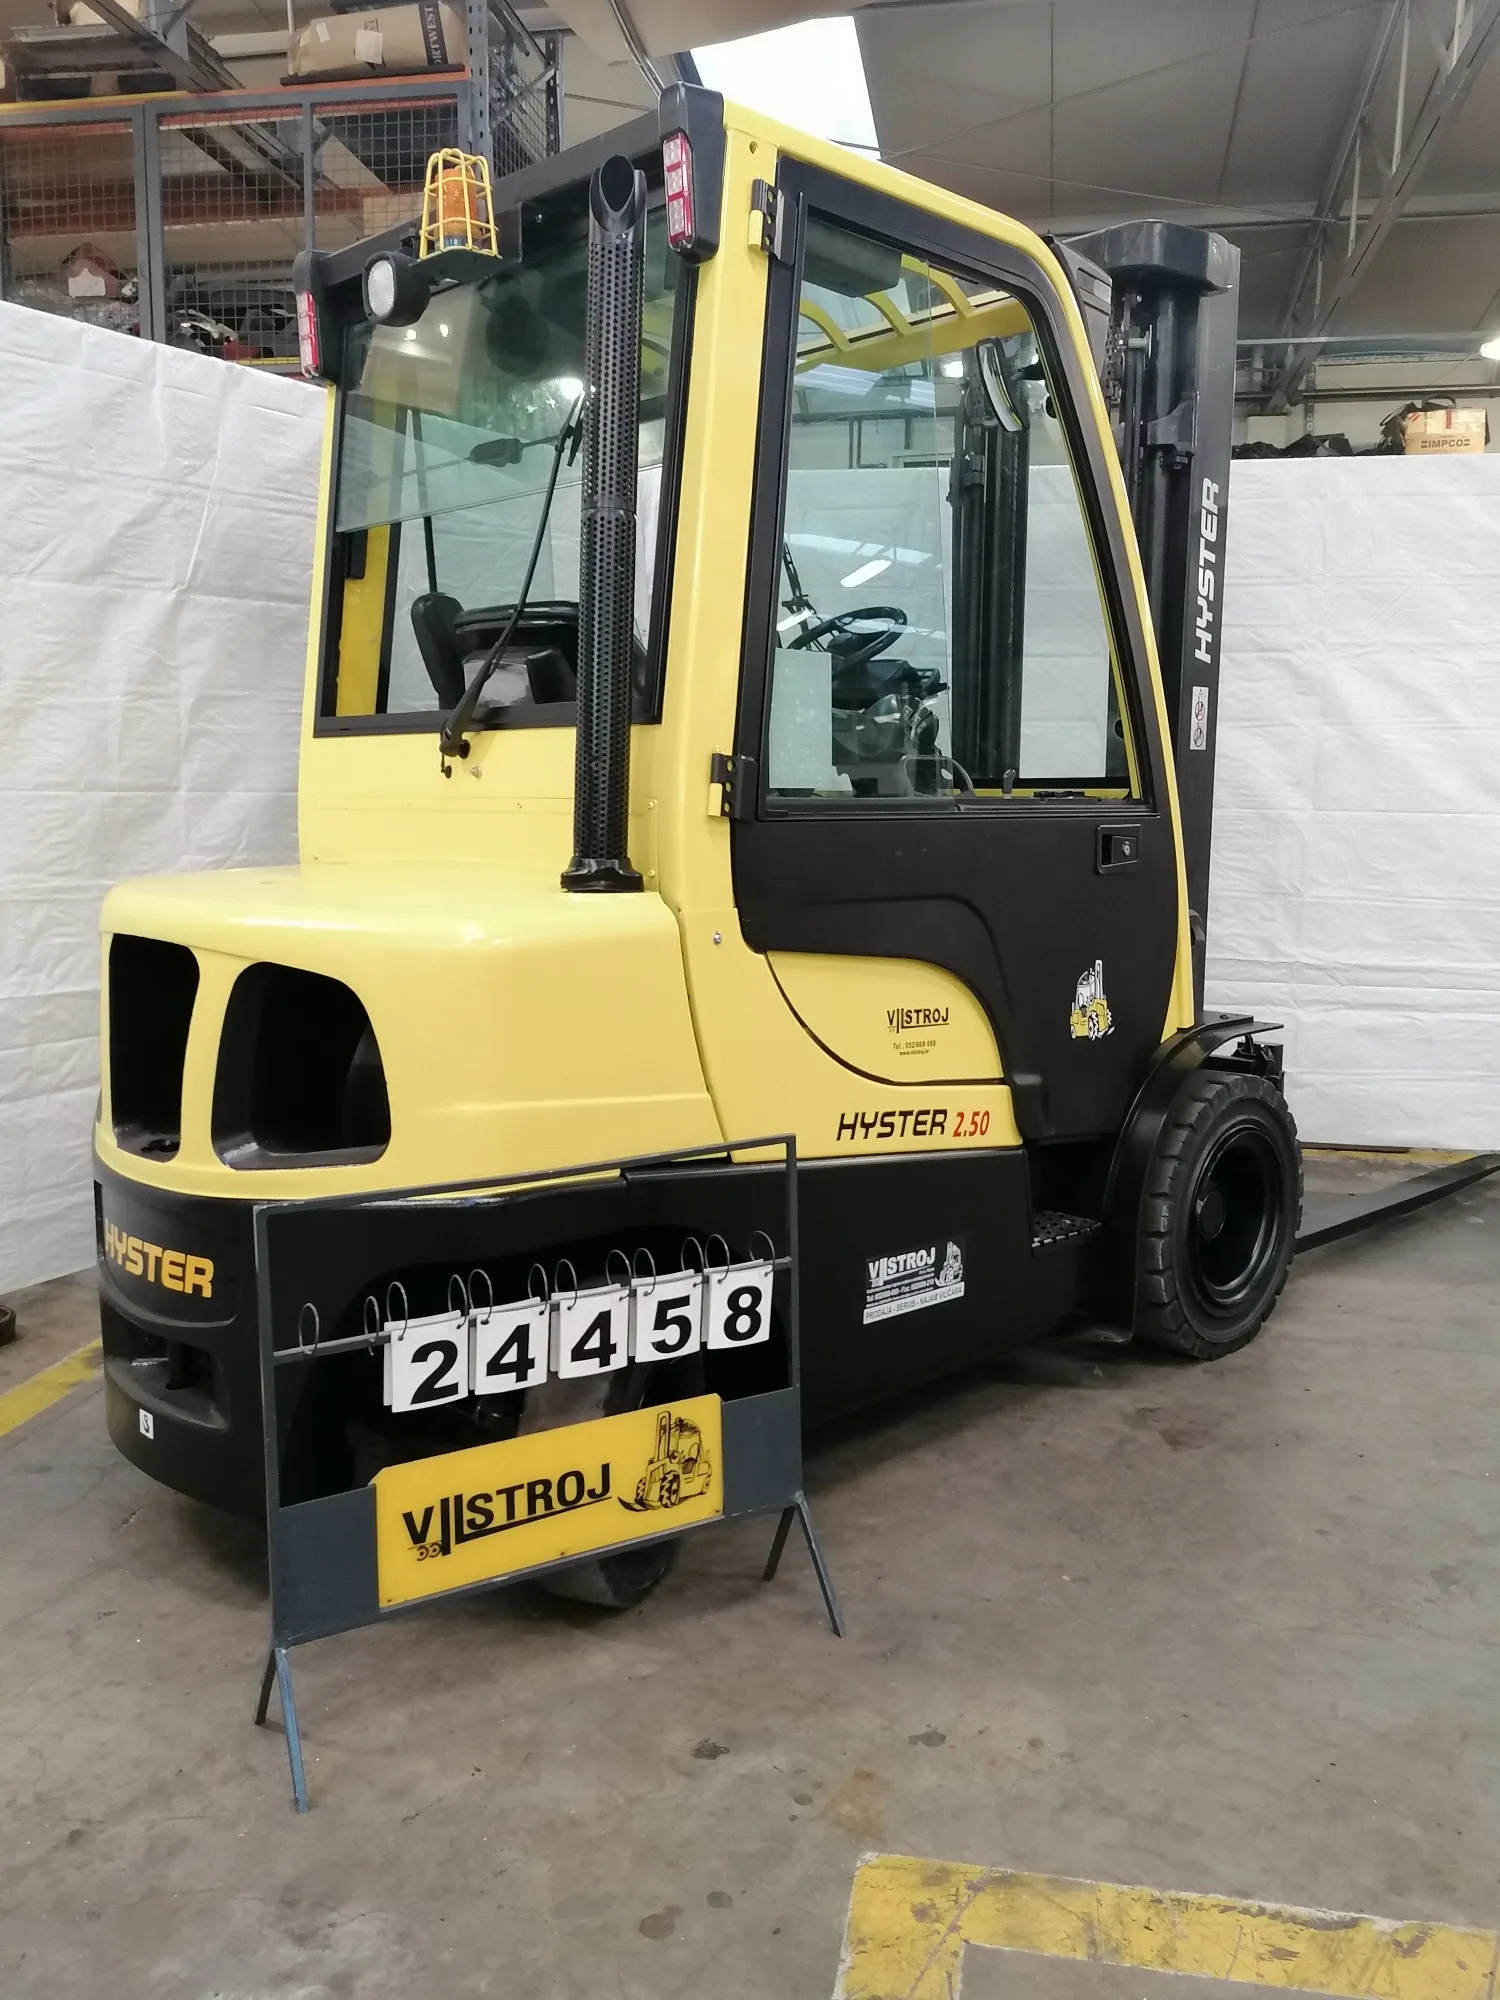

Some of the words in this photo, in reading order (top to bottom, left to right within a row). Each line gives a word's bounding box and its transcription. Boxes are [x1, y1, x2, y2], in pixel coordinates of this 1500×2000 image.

[1428, 439, 1463, 448] IMPCO
[1194, 477, 1220, 664] HYSTER
[836, 1109, 948, 1141] HYSTER
[952, 1110, 990, 1138] 2.50
[104, 1217, 214, 1298] HYSTER
[865, 1306, 893, 1321] PRODAJA
[896, 1299, 916, 1312] SERVIS
[920, 1293, 938, 1306] NAJAM
